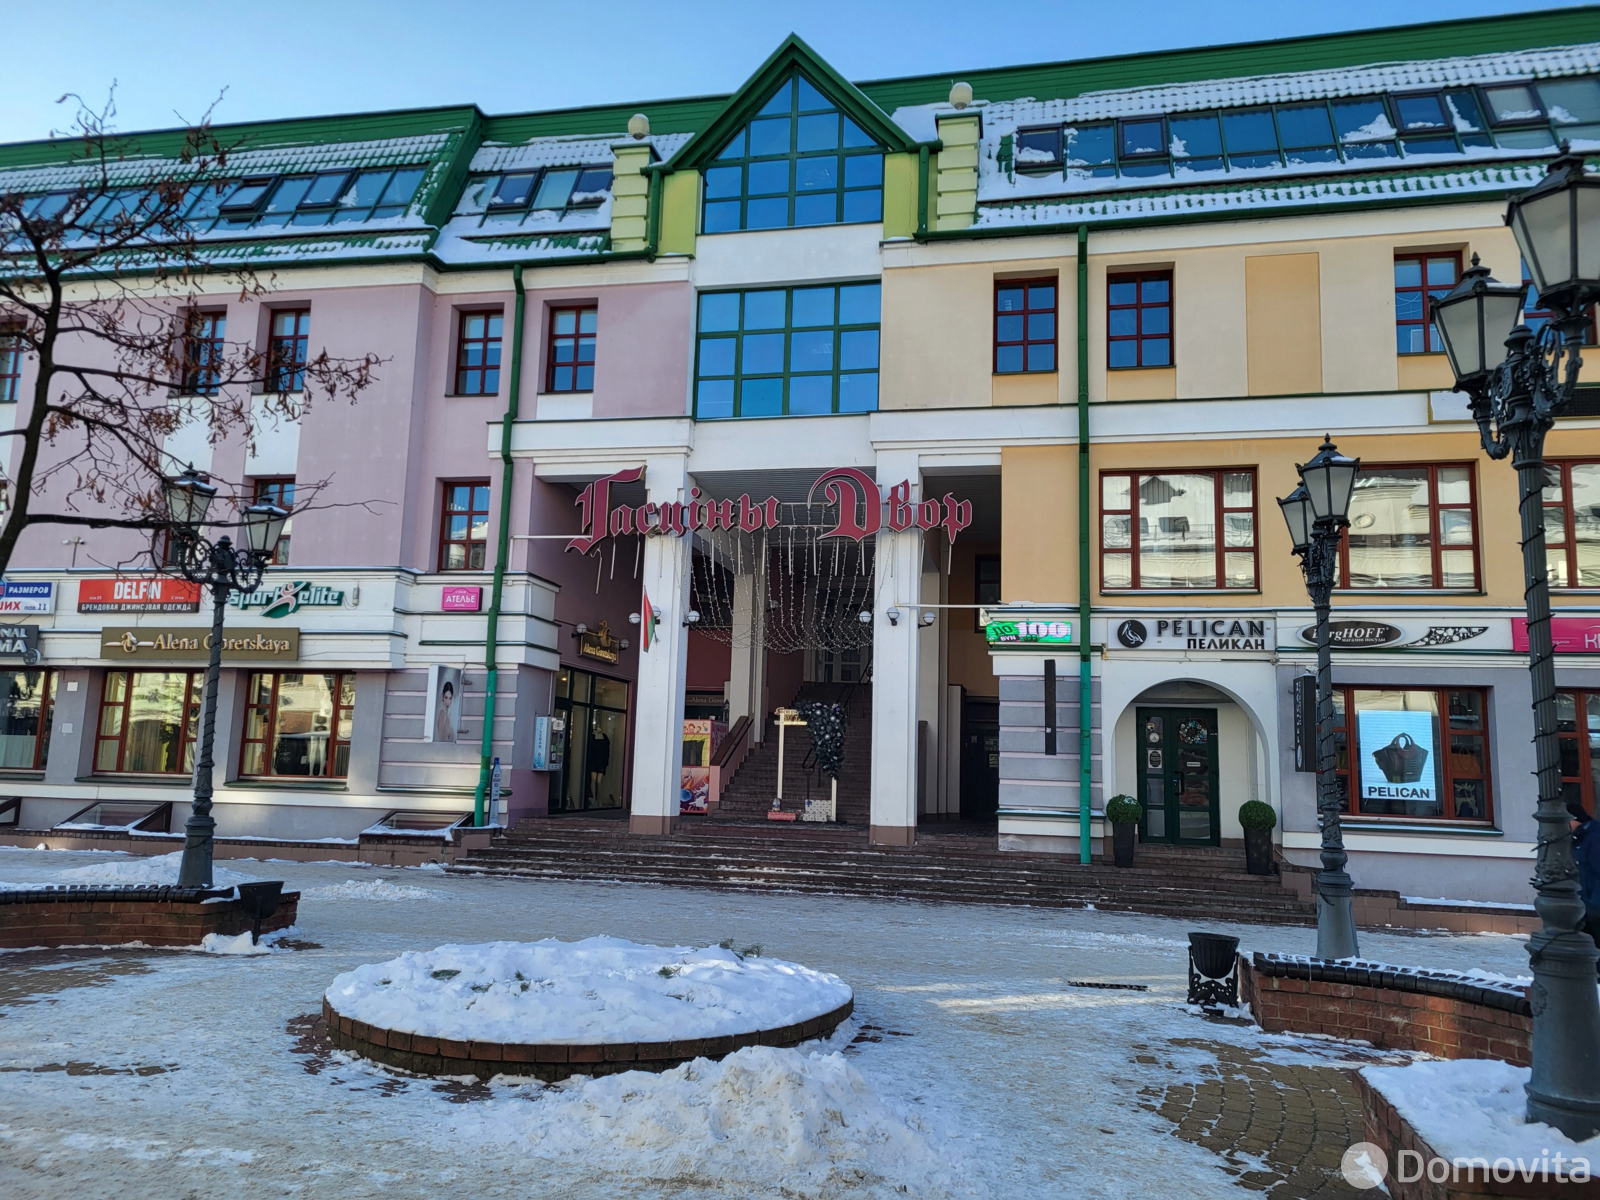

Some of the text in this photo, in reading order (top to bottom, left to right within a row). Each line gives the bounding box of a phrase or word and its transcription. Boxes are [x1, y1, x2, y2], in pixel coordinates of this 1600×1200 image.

[807, 466, 972, 545] Двор
[8, 586, 49, 594] РАЗМЕРОВ
[114, 581, 162, 600] DELFIN
[297, 586, 341, 605] elite
[81, 603, 119, 611] БРЕНДОВАЯ
[162, 603, 191, 611] ОДЕЖДА
[445, 595, 476, 603] АТЕЛЬЕ
[1014, 621, 1069, 639] 100
[1156, 620, 1265, 637] PELICAN
[153, 633, 199, 651] Alena
[1187, 639, 1265, 650] ПЕЛИКАН
[1367, 786, 1430, 799] PELICAN
